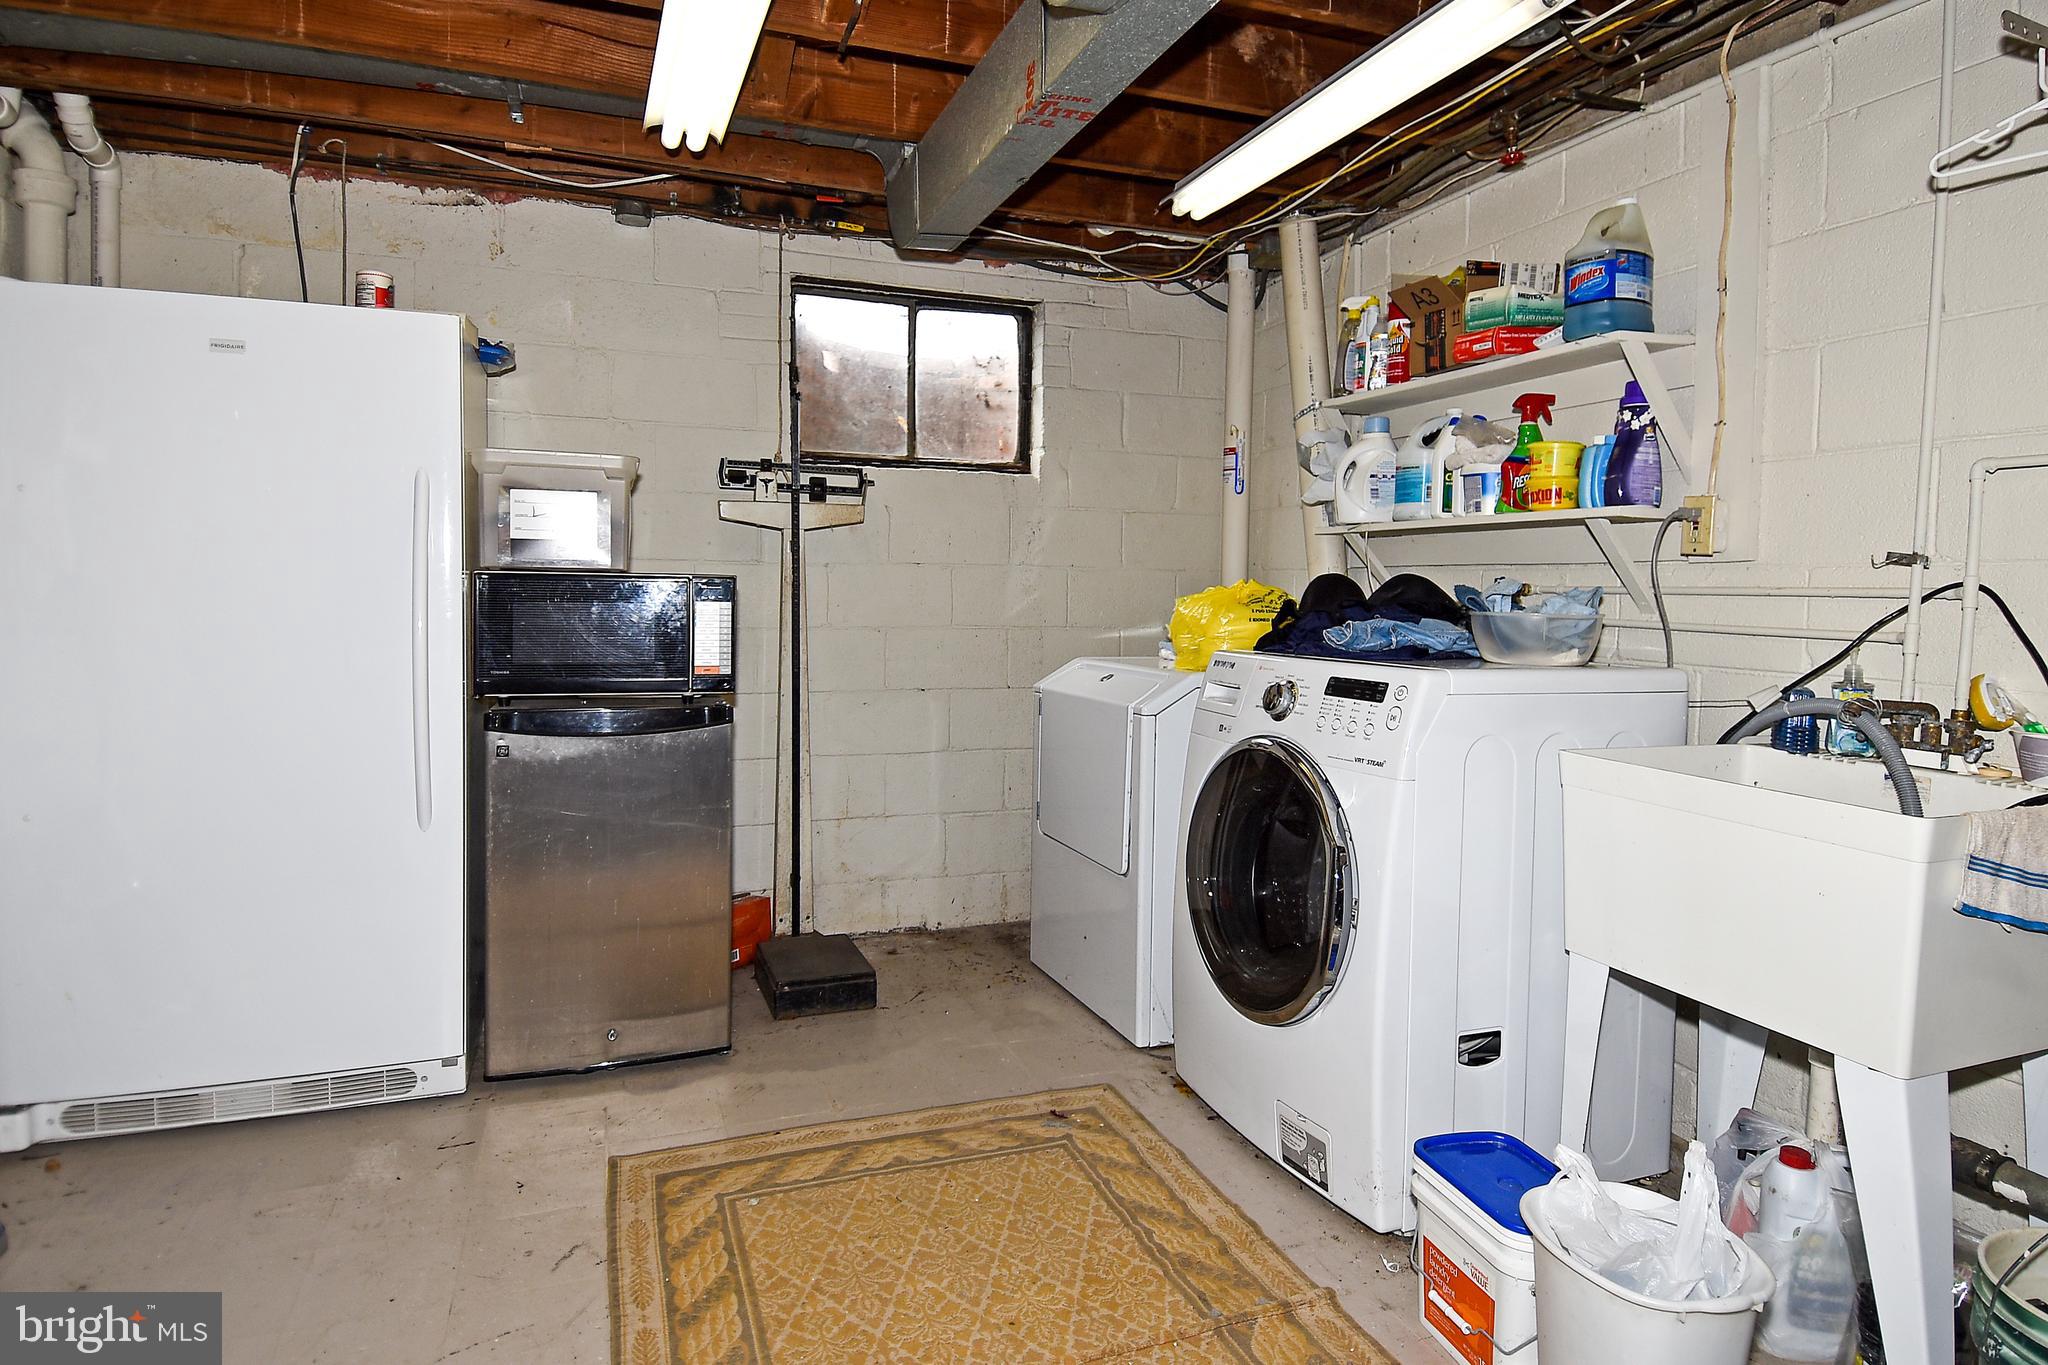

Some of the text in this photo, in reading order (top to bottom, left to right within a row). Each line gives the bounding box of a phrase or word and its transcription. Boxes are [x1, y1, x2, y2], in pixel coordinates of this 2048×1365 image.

[1569, 265, 1606, 293] Windex
[1411, 287, 1440, 310] A3
[1470, 1267, 1488, 1291] VALUE
